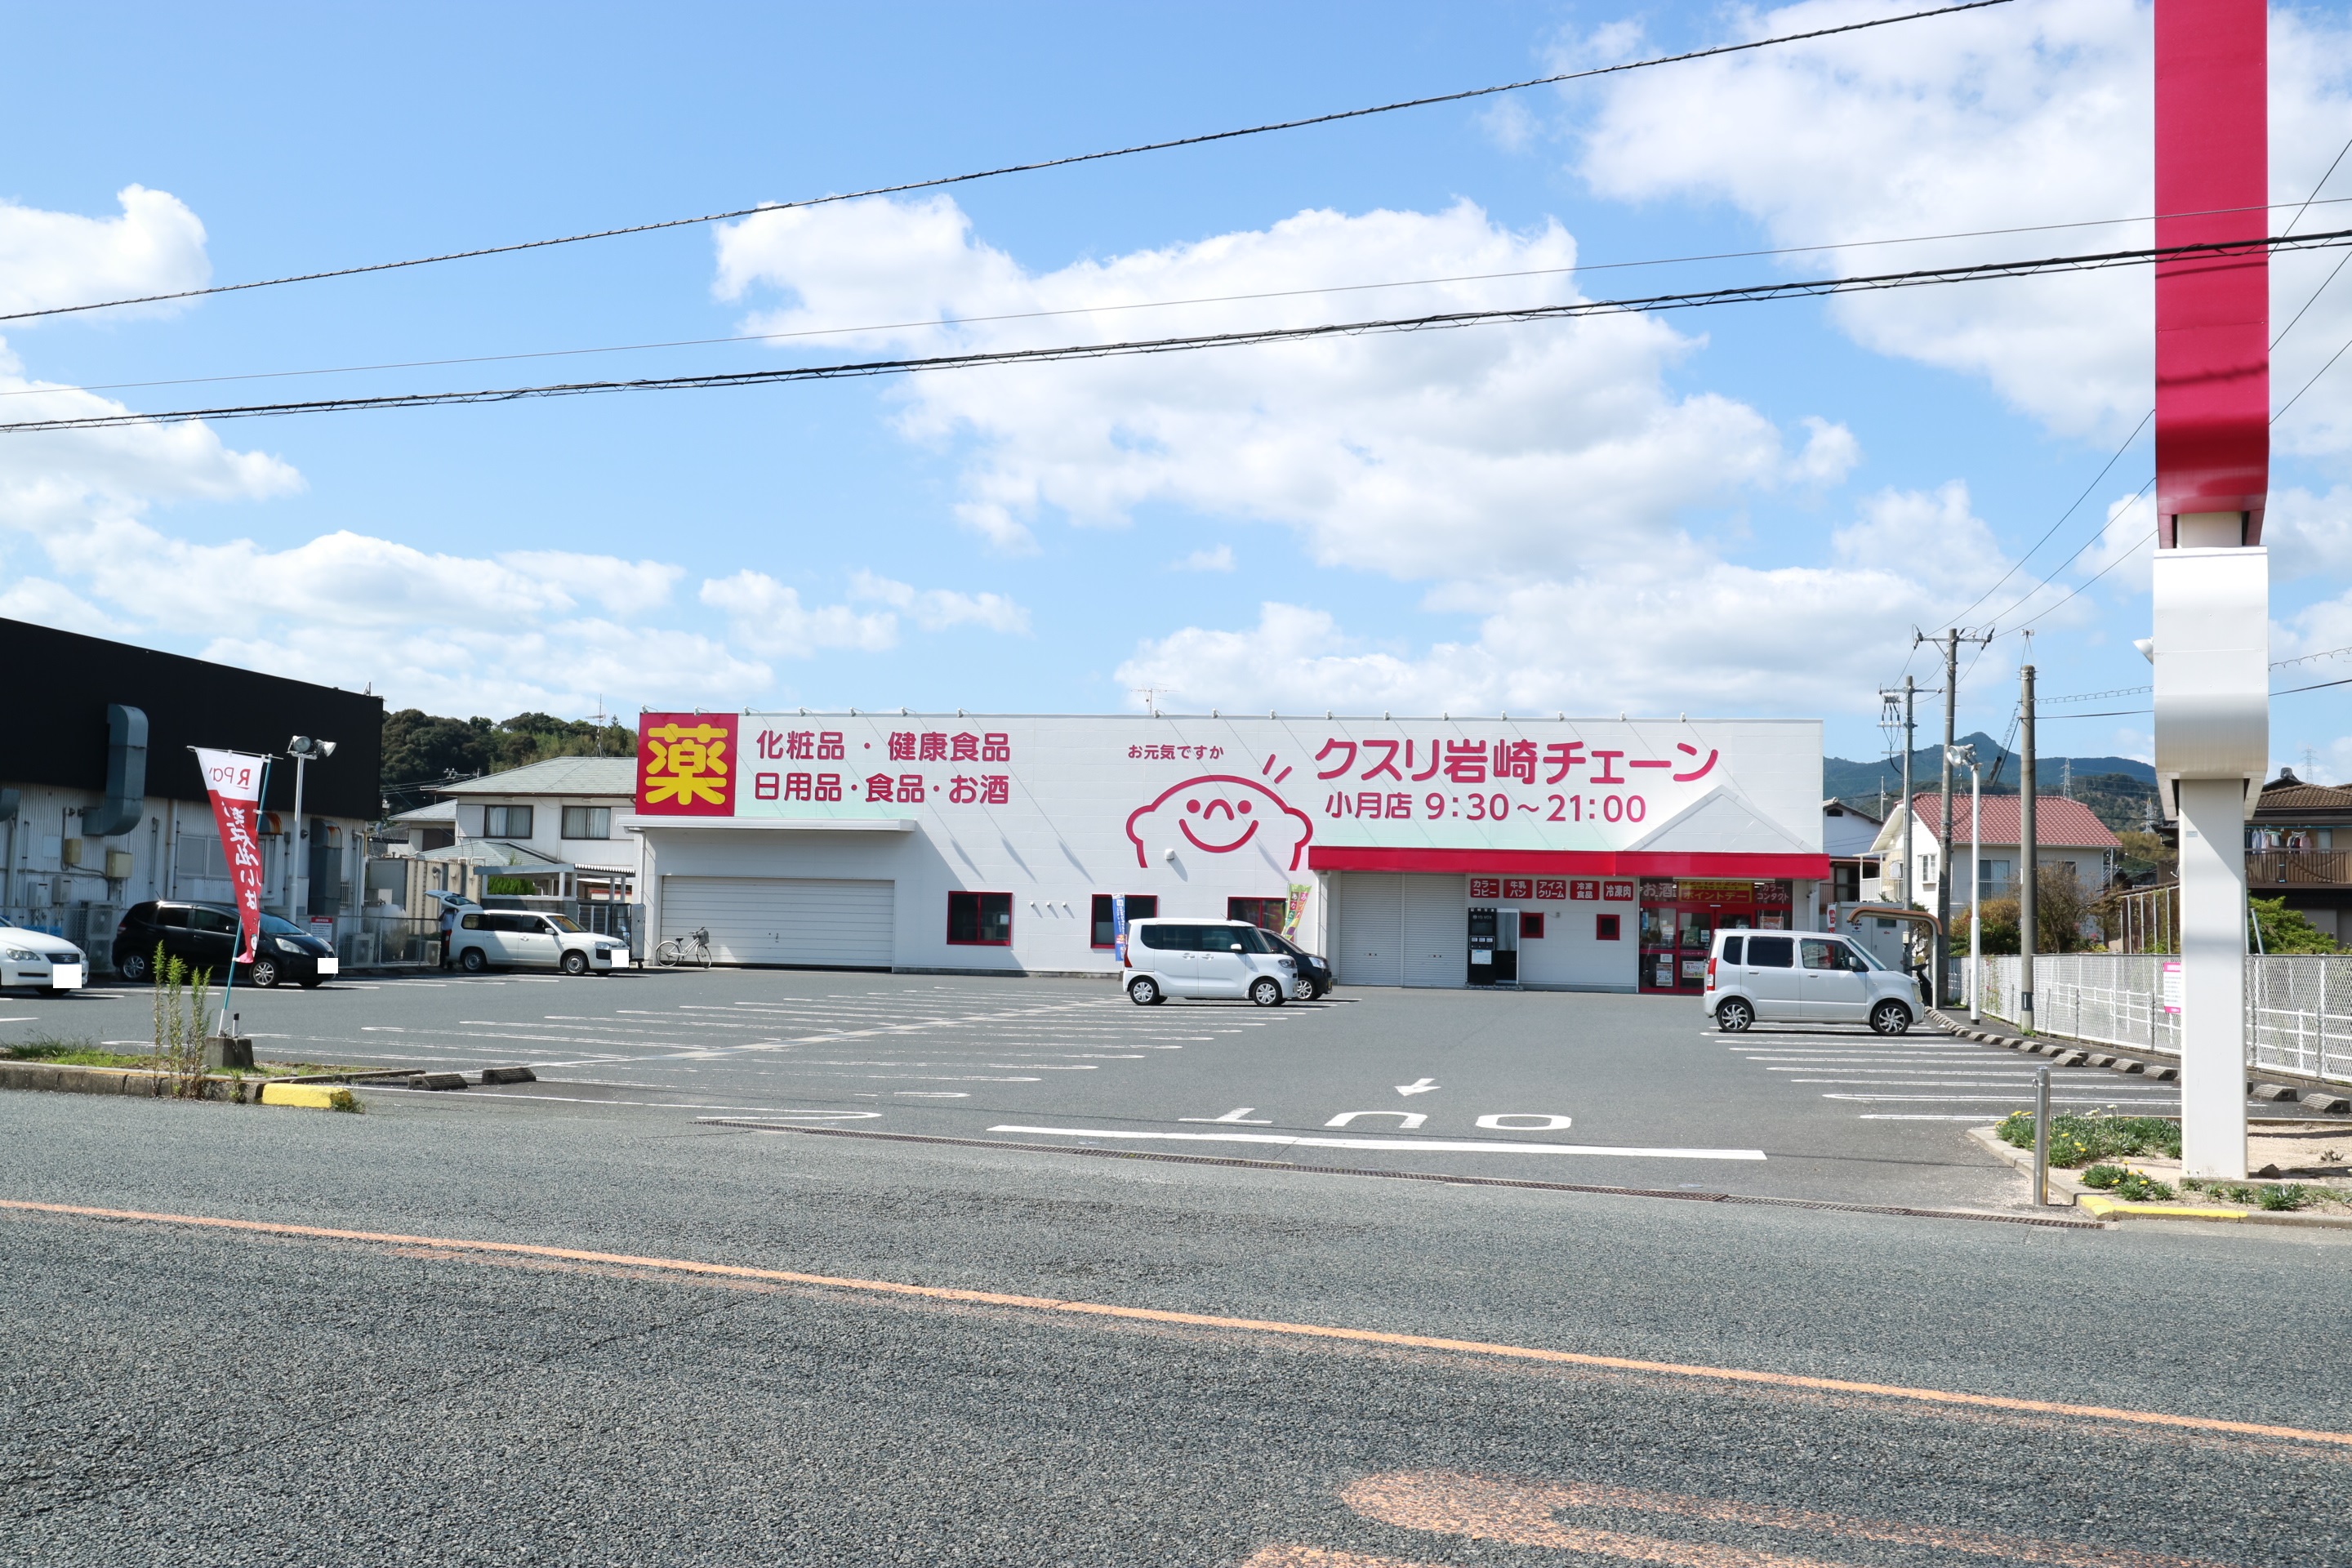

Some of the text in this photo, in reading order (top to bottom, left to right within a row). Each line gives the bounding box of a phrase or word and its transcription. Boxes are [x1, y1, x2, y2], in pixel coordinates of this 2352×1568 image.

[755, 729, 1012, 763] 化粧品・健康食品
[1127, 744, 1224, 760] お元気ですか
[644, 722, 729, 806] 薬
[1314, 737, 1719, 785] クスリ岩崎チェーン
[755, 772, 1010, 804] 日用品・食品・お酒
[1325, 791, 1413, 819] 小月店
[1510, 881, 1526, 889] 牛乳
[1539, 881, 1564, 889] アイス
[1576, 882, 1593, 890] 冷凍
[1606, 884, 1632, 898] 冷凍肉
[1643, 882, 1673, 898] お酒
[1762, 884, 1784, 892] カラー
[1473, 889, 1497, 897] コピー
[1509, 889, 1526, 898] パン
[1539, 889, 1565, 898] クリーム
[1576, 890, 1593, 899] 食品
[1178, 1107, 1573, 1131] OUT
